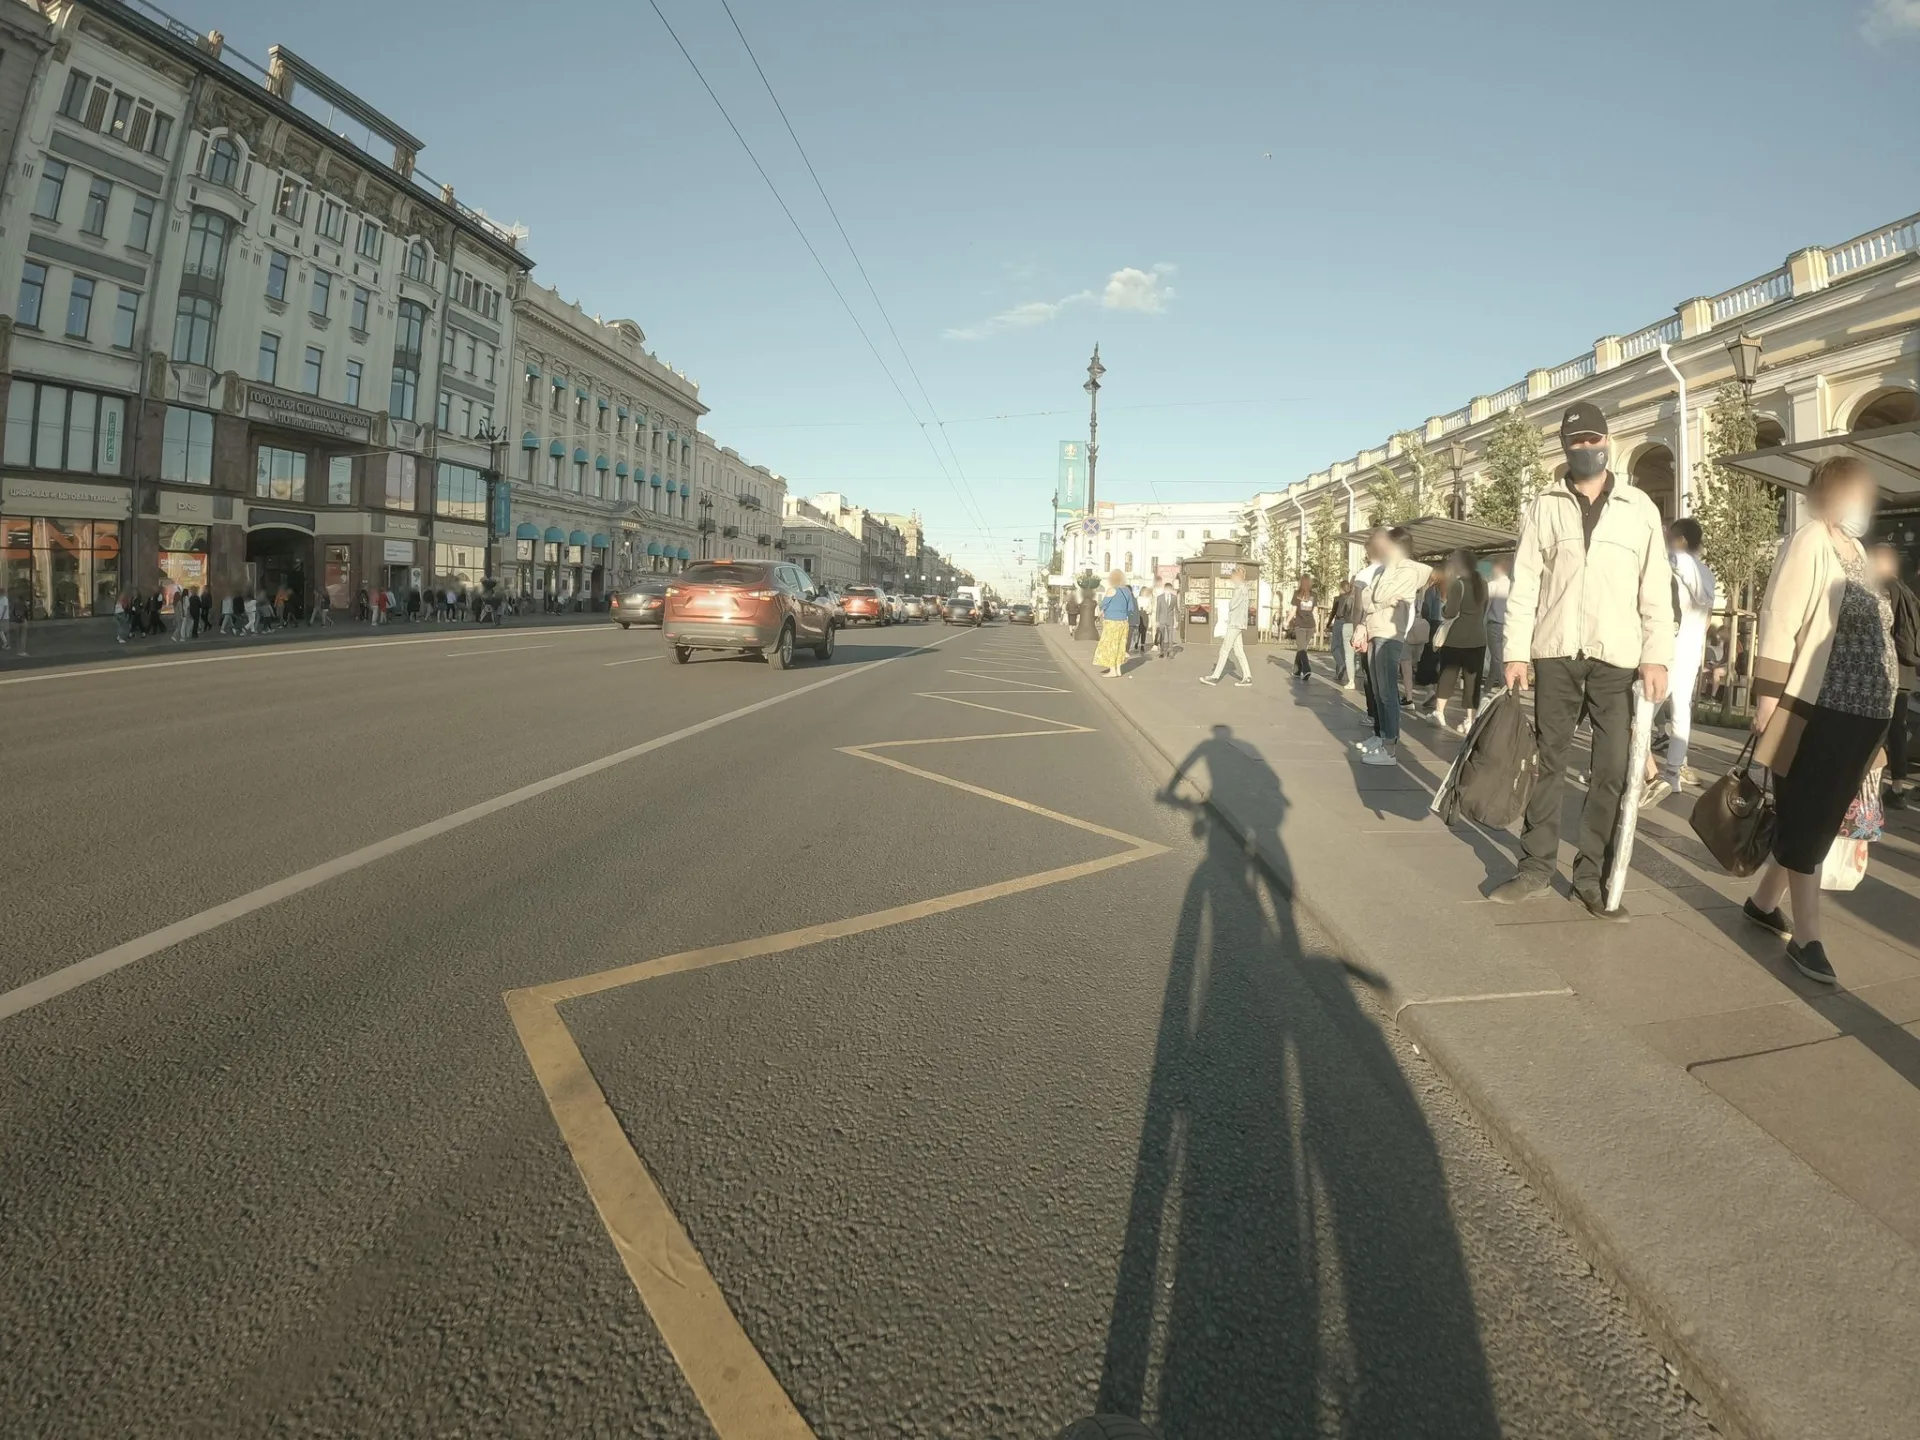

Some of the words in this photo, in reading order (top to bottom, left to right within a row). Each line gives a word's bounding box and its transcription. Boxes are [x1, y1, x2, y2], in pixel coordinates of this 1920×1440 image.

[250, 391, 295, 410] ГОРОДСКАЯ
[297, 402, 370, 427] СТОМАТОЛОГИЧЕСКАЯ
[10, 487, 50, 498] ЦИФРОВАЯ
[58, 492, 90, 501] БЫТОВАЯ
[90, 494, 119, 503] ТЕХНИКА
[178, 502, 199, 511] DNS
